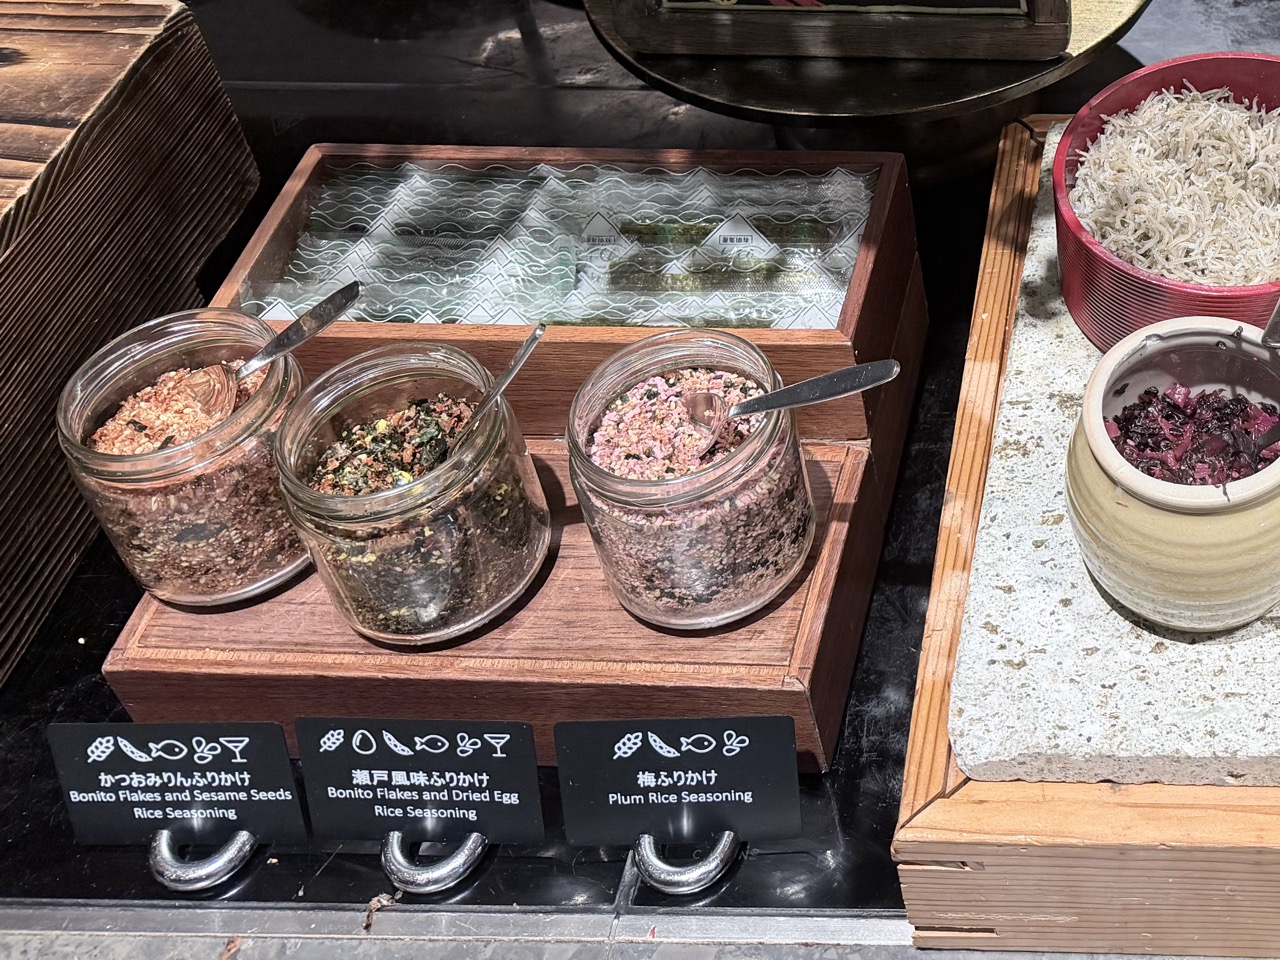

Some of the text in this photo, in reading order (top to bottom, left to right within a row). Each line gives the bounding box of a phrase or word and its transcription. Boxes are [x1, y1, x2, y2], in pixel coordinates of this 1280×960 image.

[99, 771, 251, 788] かつおみりんふりかけ
[351, 769, 490, 788] 瀬戸風味ふりかけ
[636, 770, 718, 788] 梅ふりかけ
[69, 787, 293, 803] Bonito Flakes and Sesame Seeds
[327, 786, 520, 805] Bonito Flakes and Dried Egg
[608, 790, 753, 805] Plum Rice Seasoning
[133, 806, 238, 820] Rice Seasoning
[373, 805, 478, 821] Rice Seasoning
